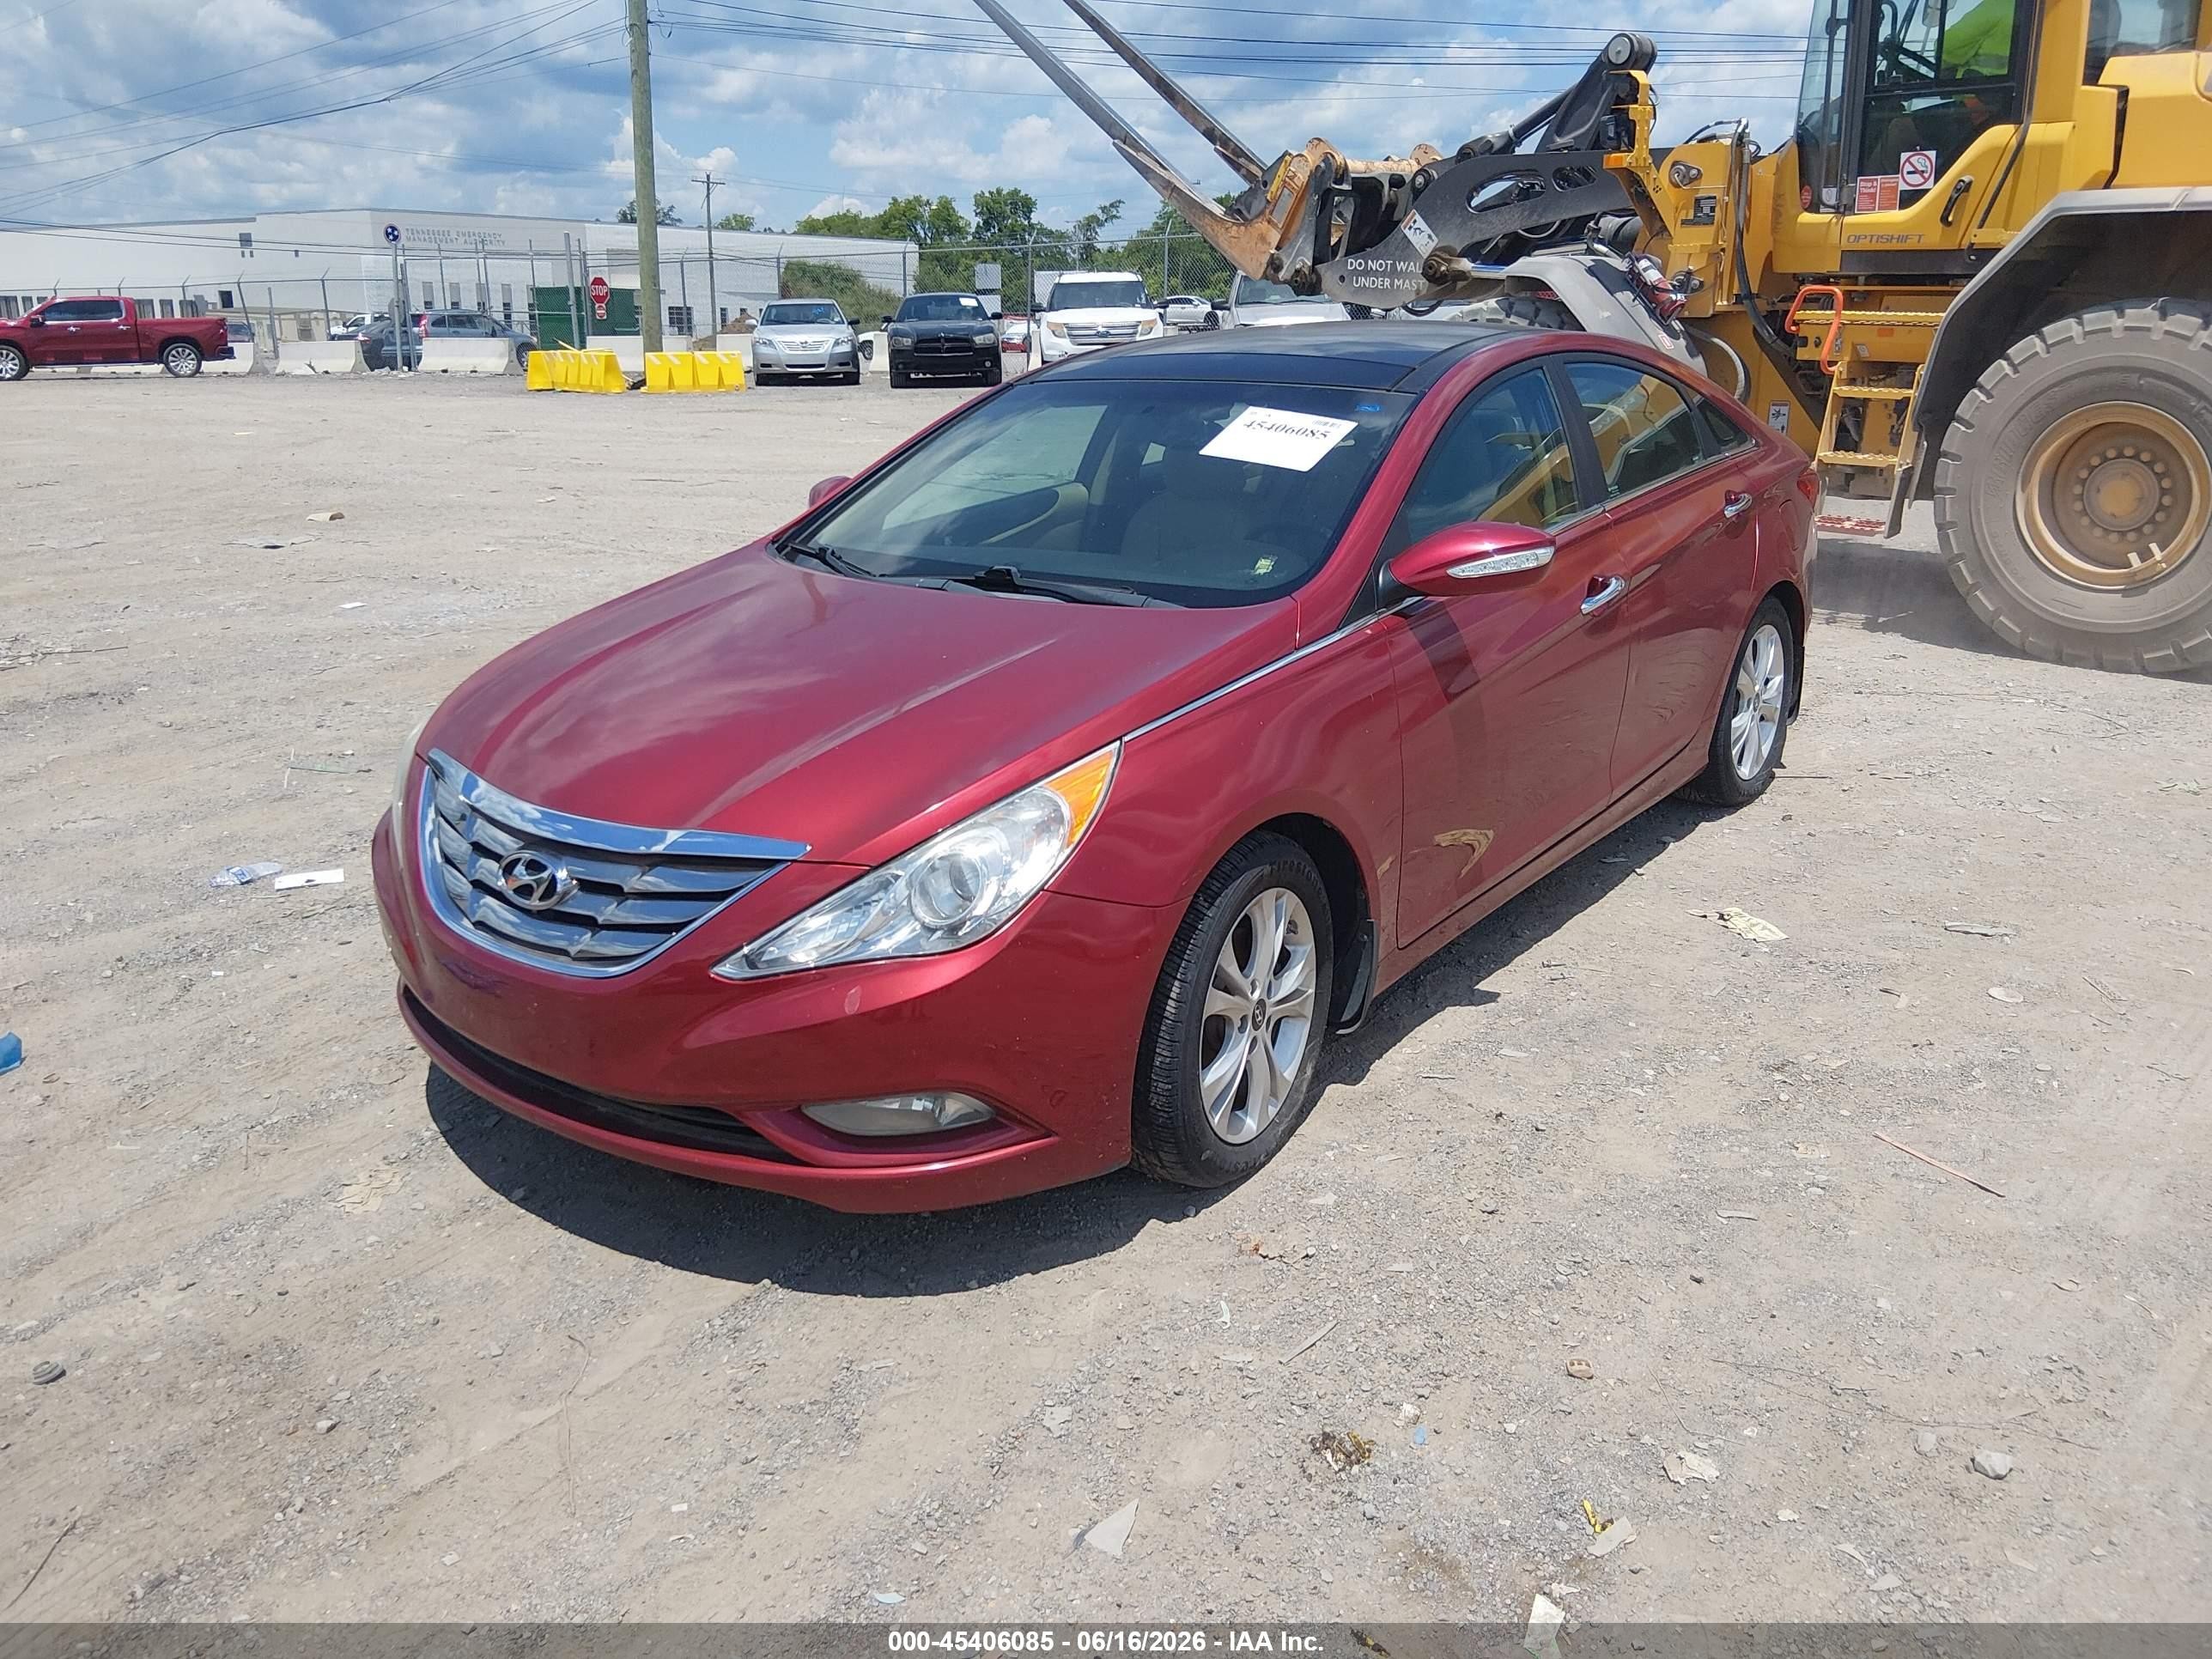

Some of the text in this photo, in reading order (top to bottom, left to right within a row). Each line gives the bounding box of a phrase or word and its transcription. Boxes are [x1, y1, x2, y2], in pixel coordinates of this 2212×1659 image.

[405, 228, 502, 239] TENNESSEE EMERGENCY
[1847, 234, 1925, 244] OPTISHIFT
[406, 236, 507, 246] MANAGEMENT AUTHORITY
[1347, 258, 1423, 273] DO NOT WAL
[1352, 276, 1425, 290] UNDER MAST
[591, 284, 608, 296] STOP
[1243, 420, 1331, 440] 45406085
